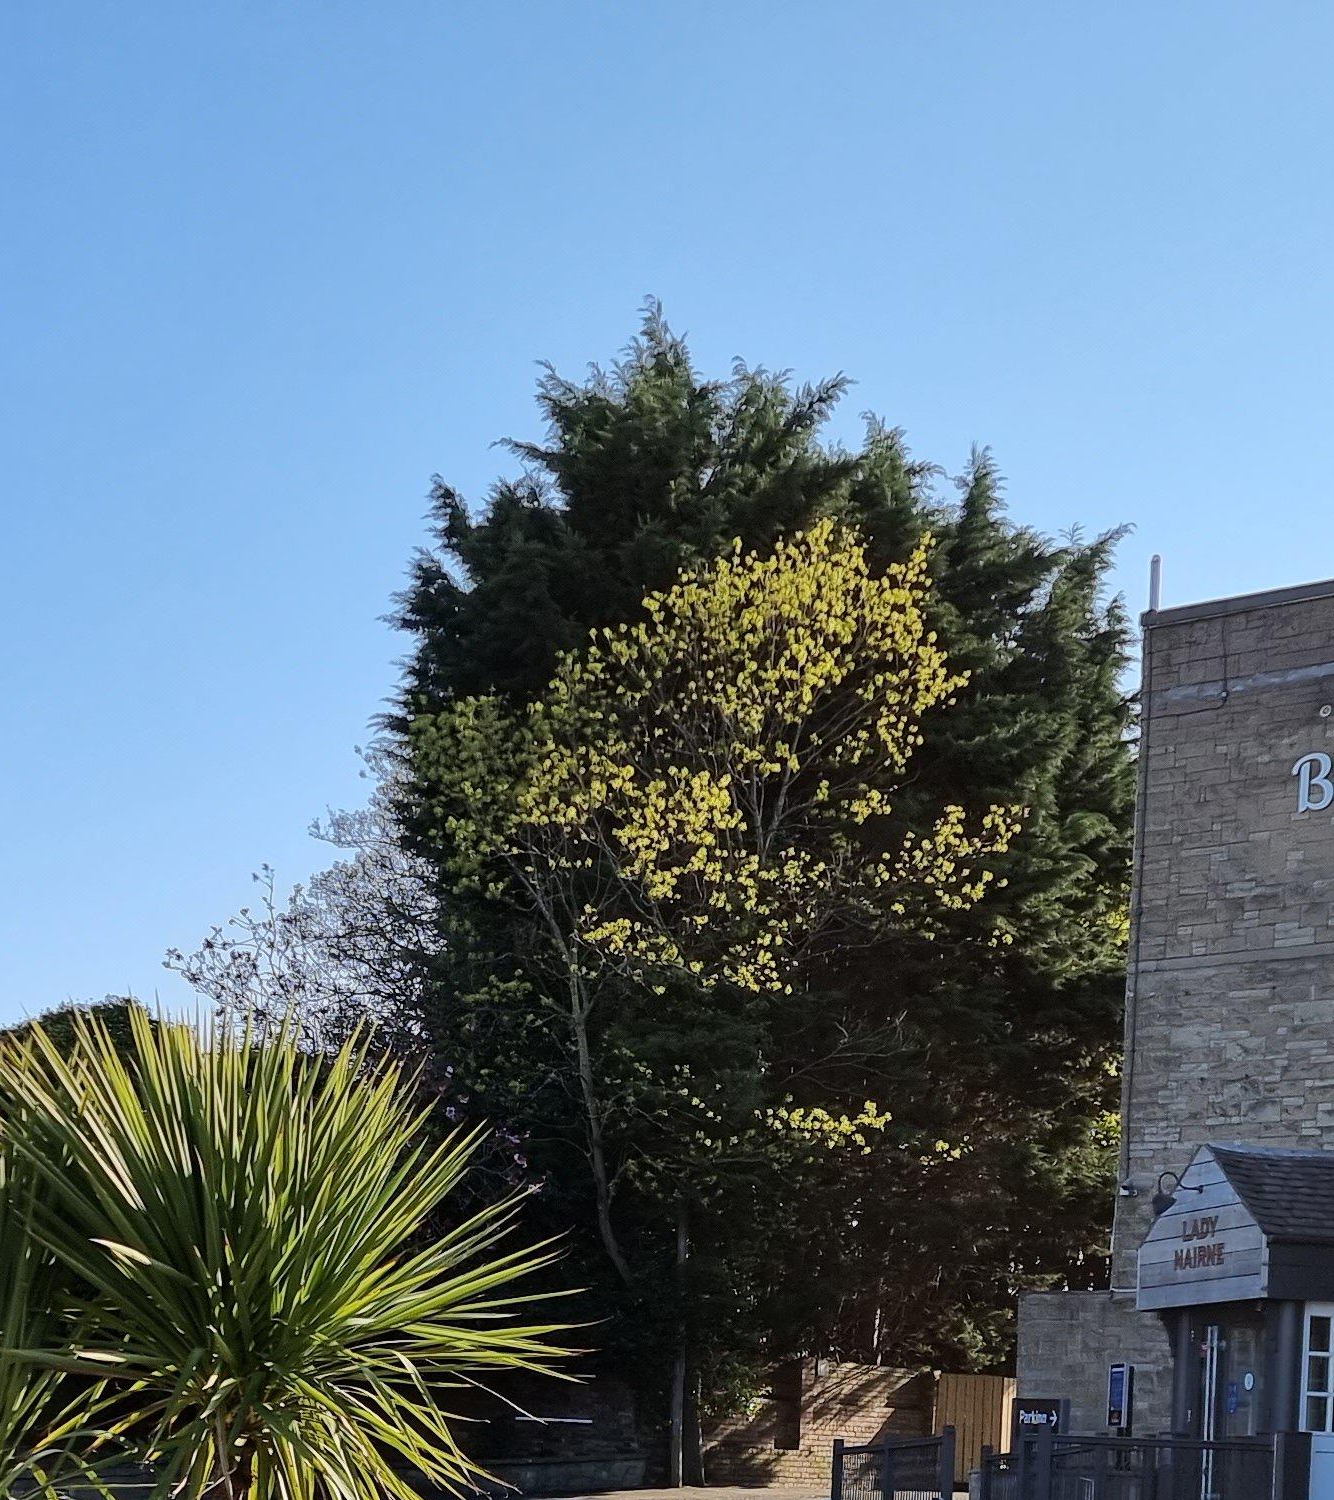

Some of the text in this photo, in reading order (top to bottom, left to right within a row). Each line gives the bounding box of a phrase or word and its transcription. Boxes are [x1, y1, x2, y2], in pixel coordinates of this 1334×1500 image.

[1181, 1214, 1219, 1243] LADY
[1173, 1242, 1225, 1271] NAIRNE
[1018, 1409, 1047, 1425] Parking
